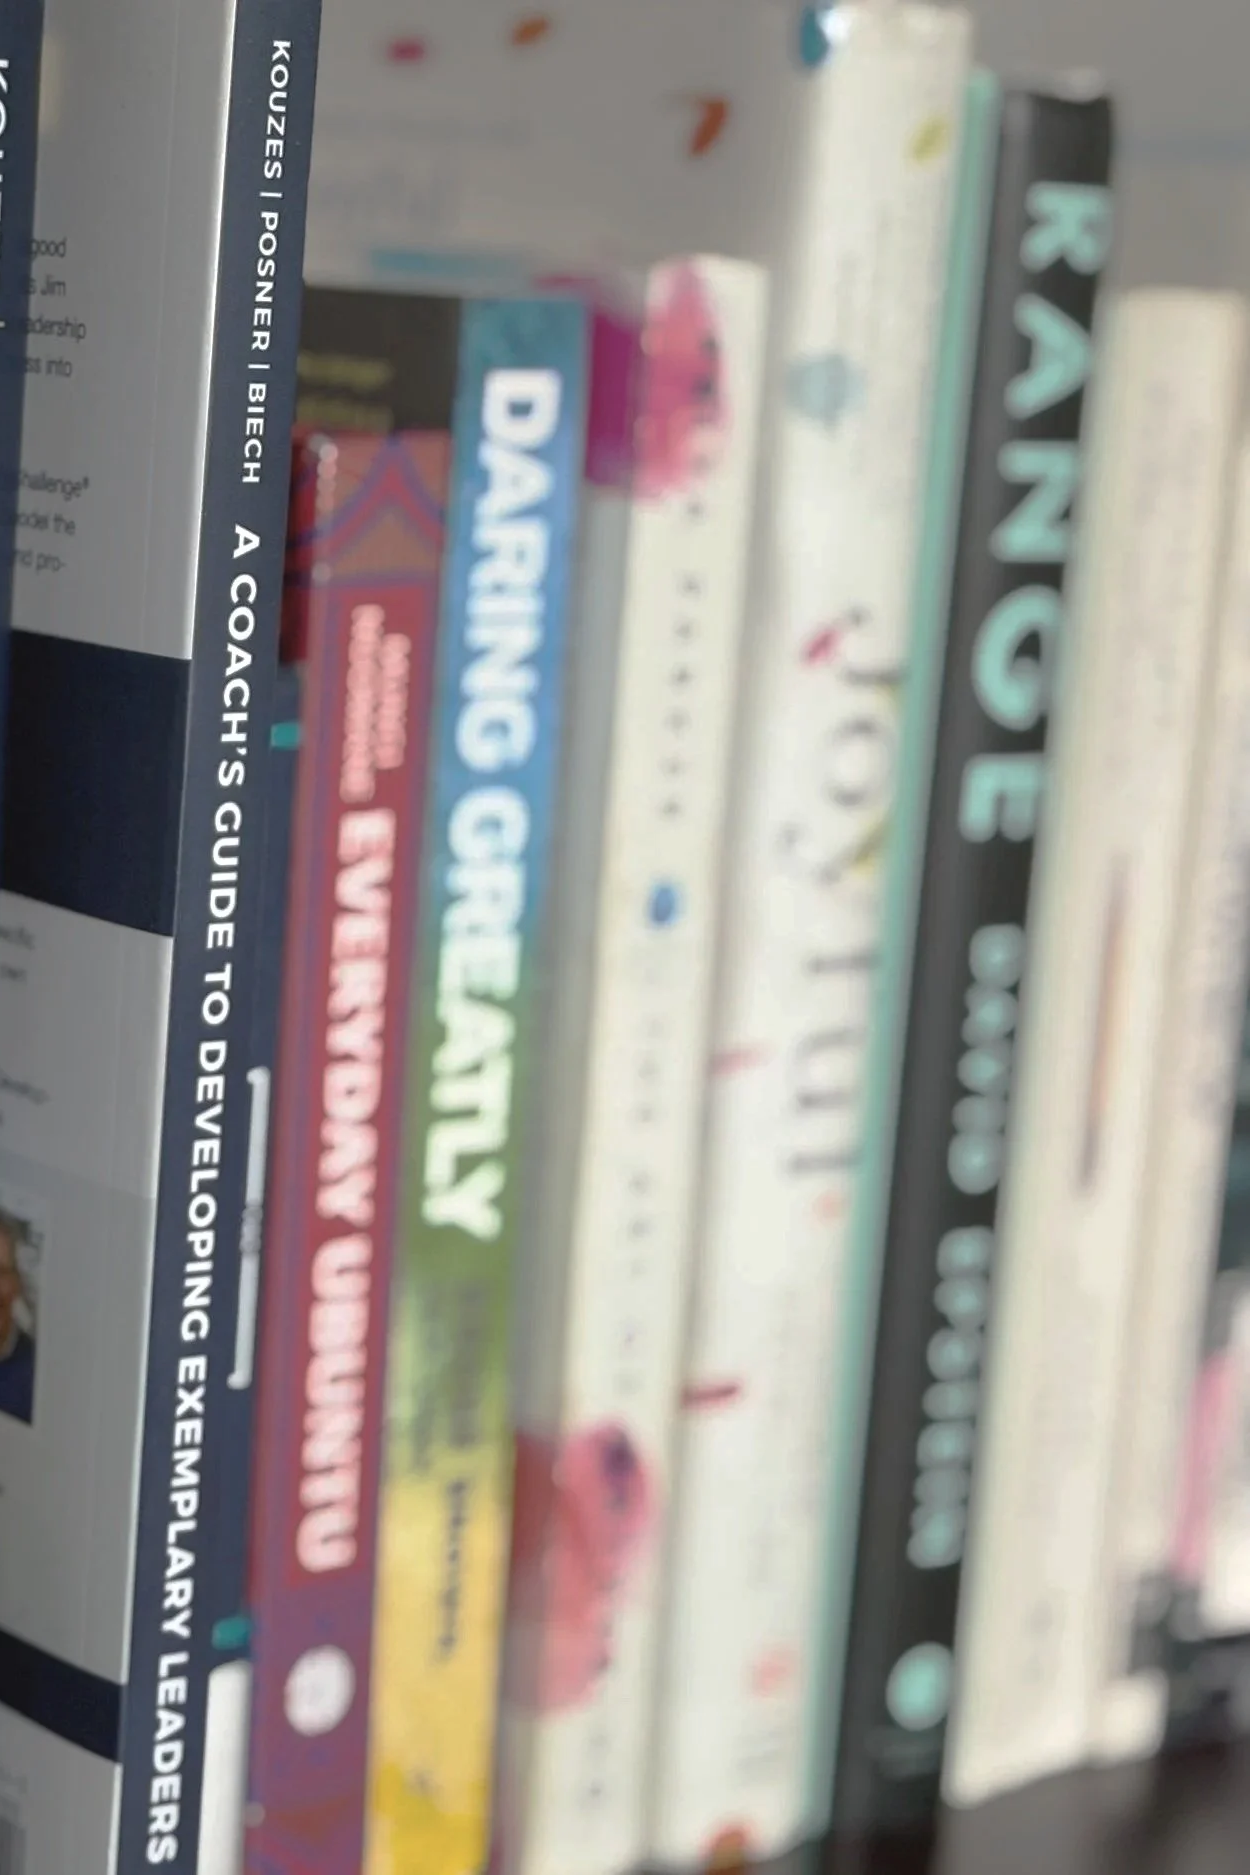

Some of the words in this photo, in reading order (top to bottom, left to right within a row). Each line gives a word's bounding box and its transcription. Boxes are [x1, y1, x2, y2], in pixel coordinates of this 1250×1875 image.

[264, 39, 291, 180] KOUZES
[252, 211, 279, 351] POSNER
[242, 382, 267, 484] BIECH
[233, 523, 261, 560] A
[455, 369, 562, 773] DARING
[218, 573, 257, 787] COACH'S
[207, 801, 243, 950] GUIDE
[201, 963, 233, 1025] TO
[315, 807, 396, 1227] EVERYDAY
[422, 785, 532, 1242] GREATLY
[180, 1040, 227, 1342] DEVELOPING
[161, 1354, 207, 1639] EXEMPLARY
[295, 1233, 374, 1573] UBUNTU
[145, 1651, 190, 1865] LEADERS
